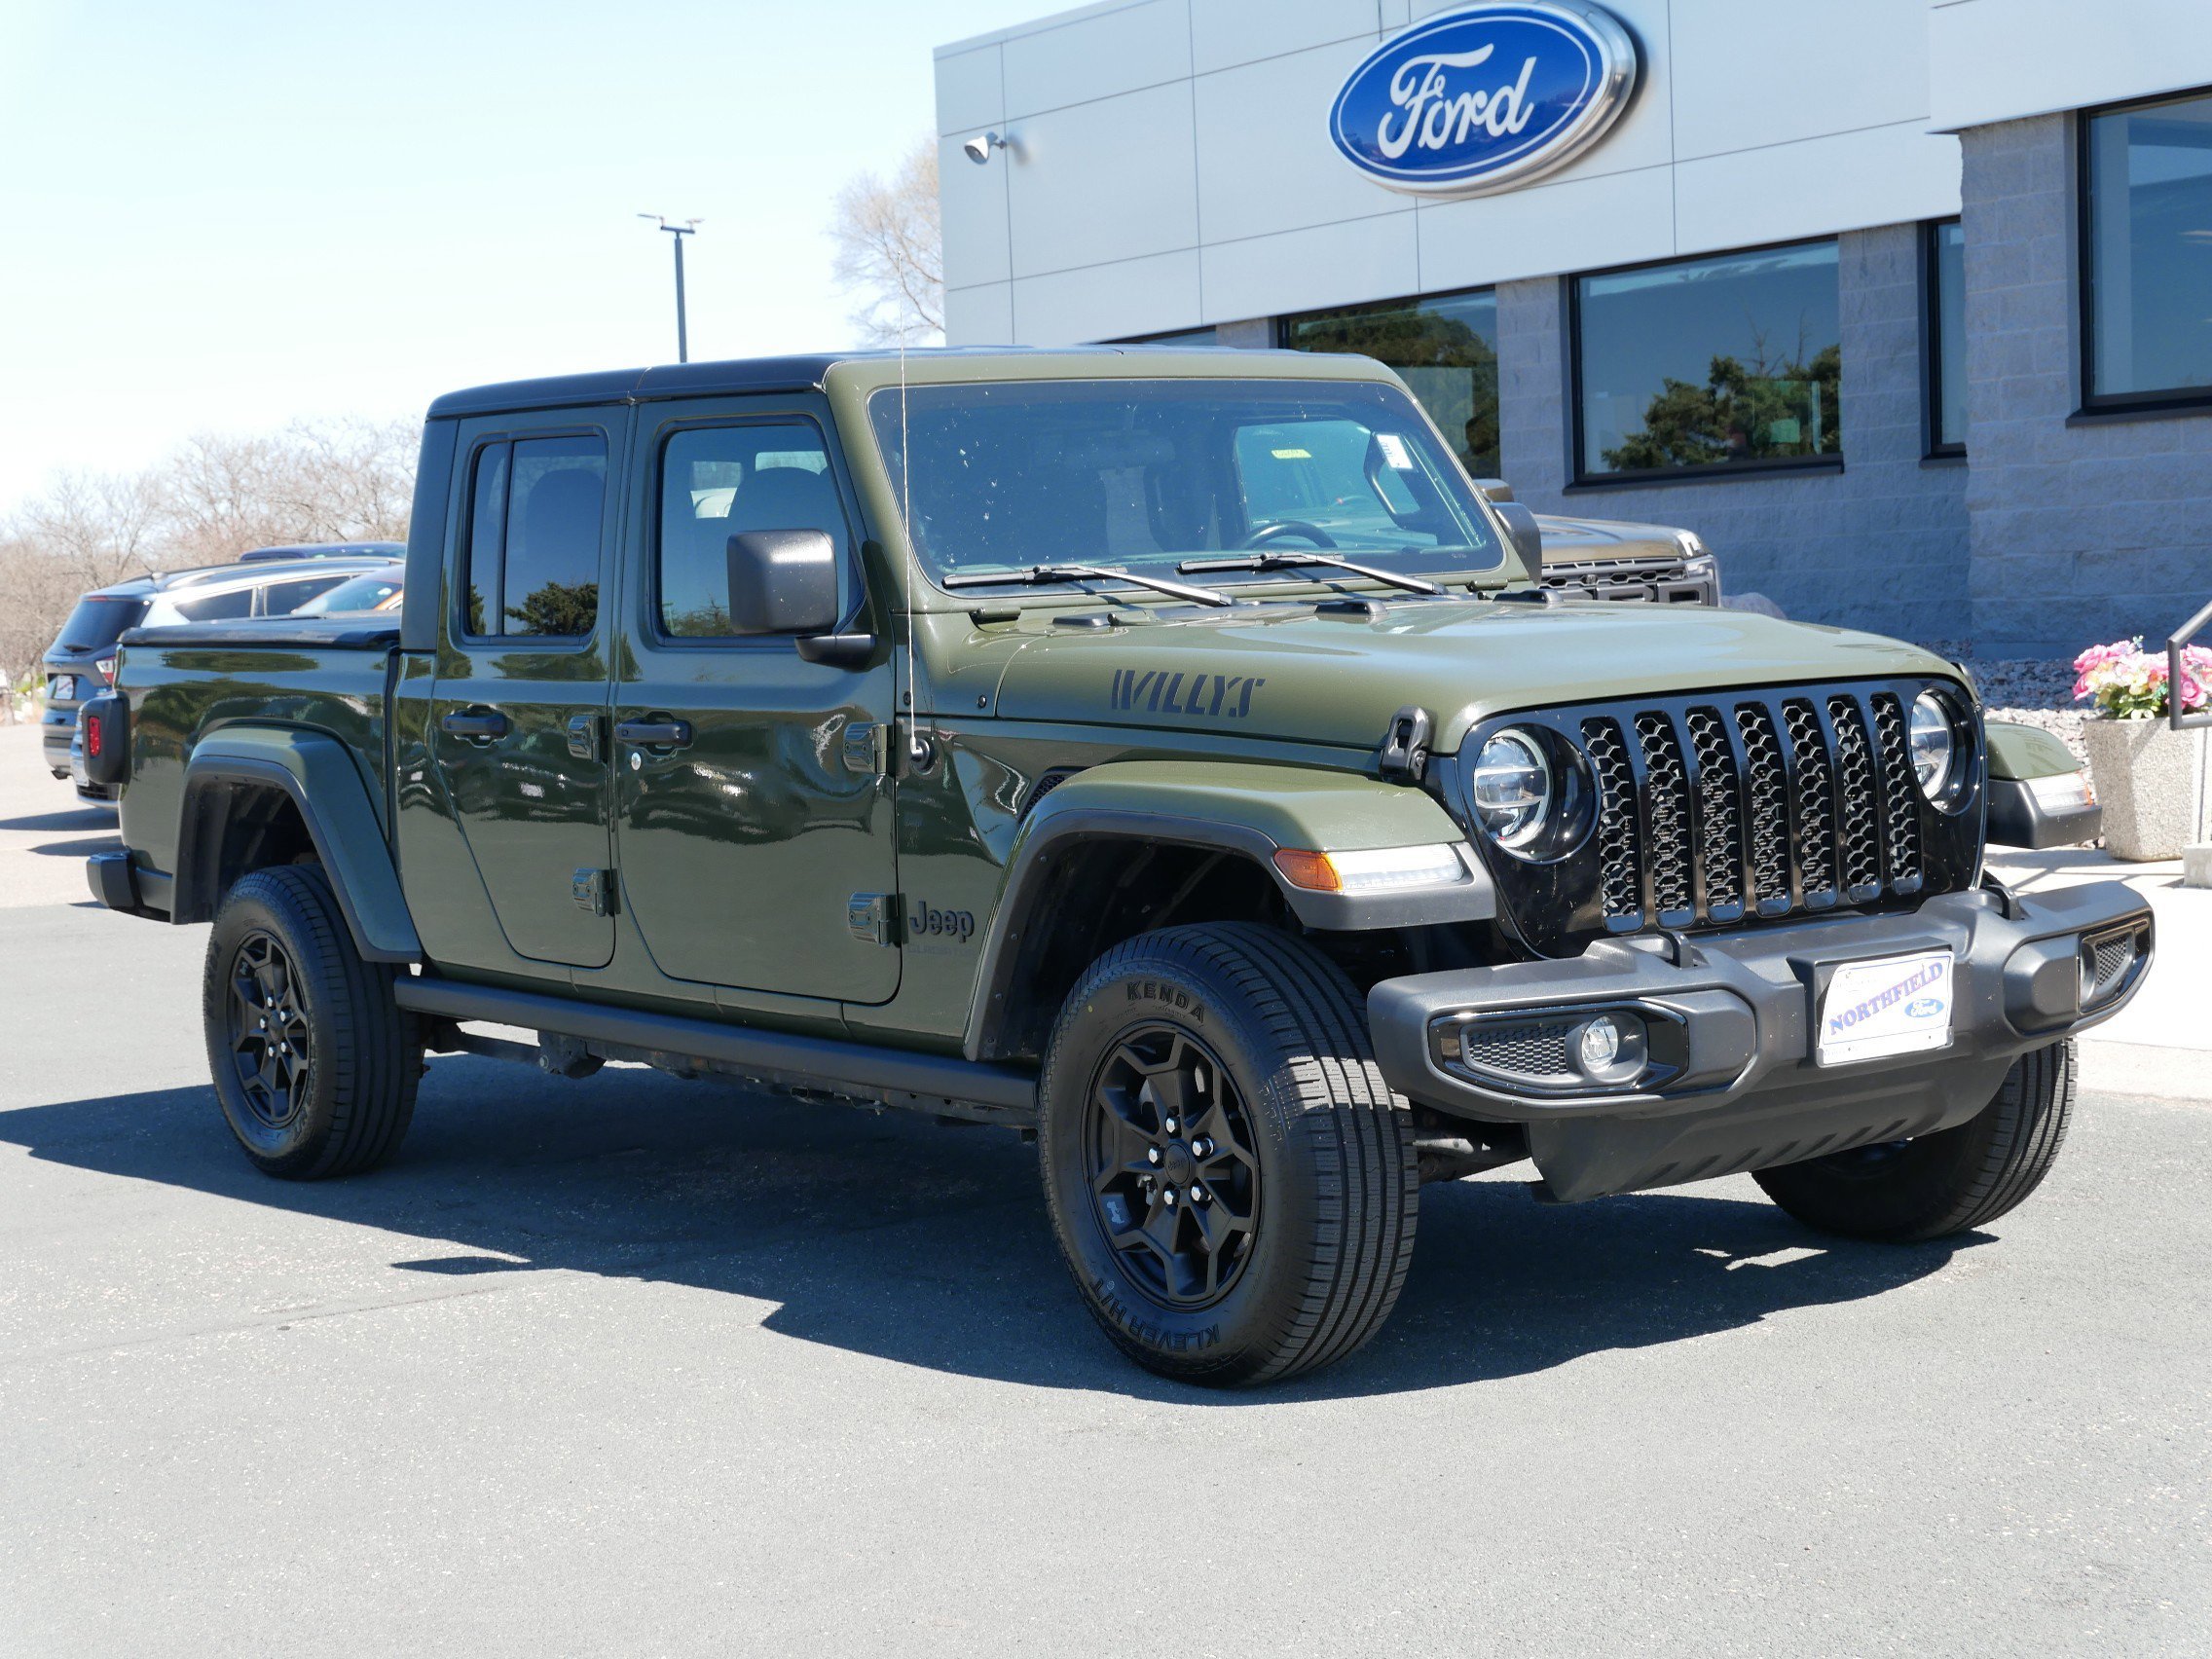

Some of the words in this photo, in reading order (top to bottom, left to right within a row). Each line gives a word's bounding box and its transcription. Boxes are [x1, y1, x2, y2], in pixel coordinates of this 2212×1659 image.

[1378, 43, 1537, 160] Ford
[1111, 669, 1266, 718] WILLYS
[909, 901, 975, 943] Jeep
[1126, 980, 1204, 1023] KENDA
[1828, 962, 1943, 1036] NORTHFIELD
[1127, 1315, 1221, 1352] KLEVER
